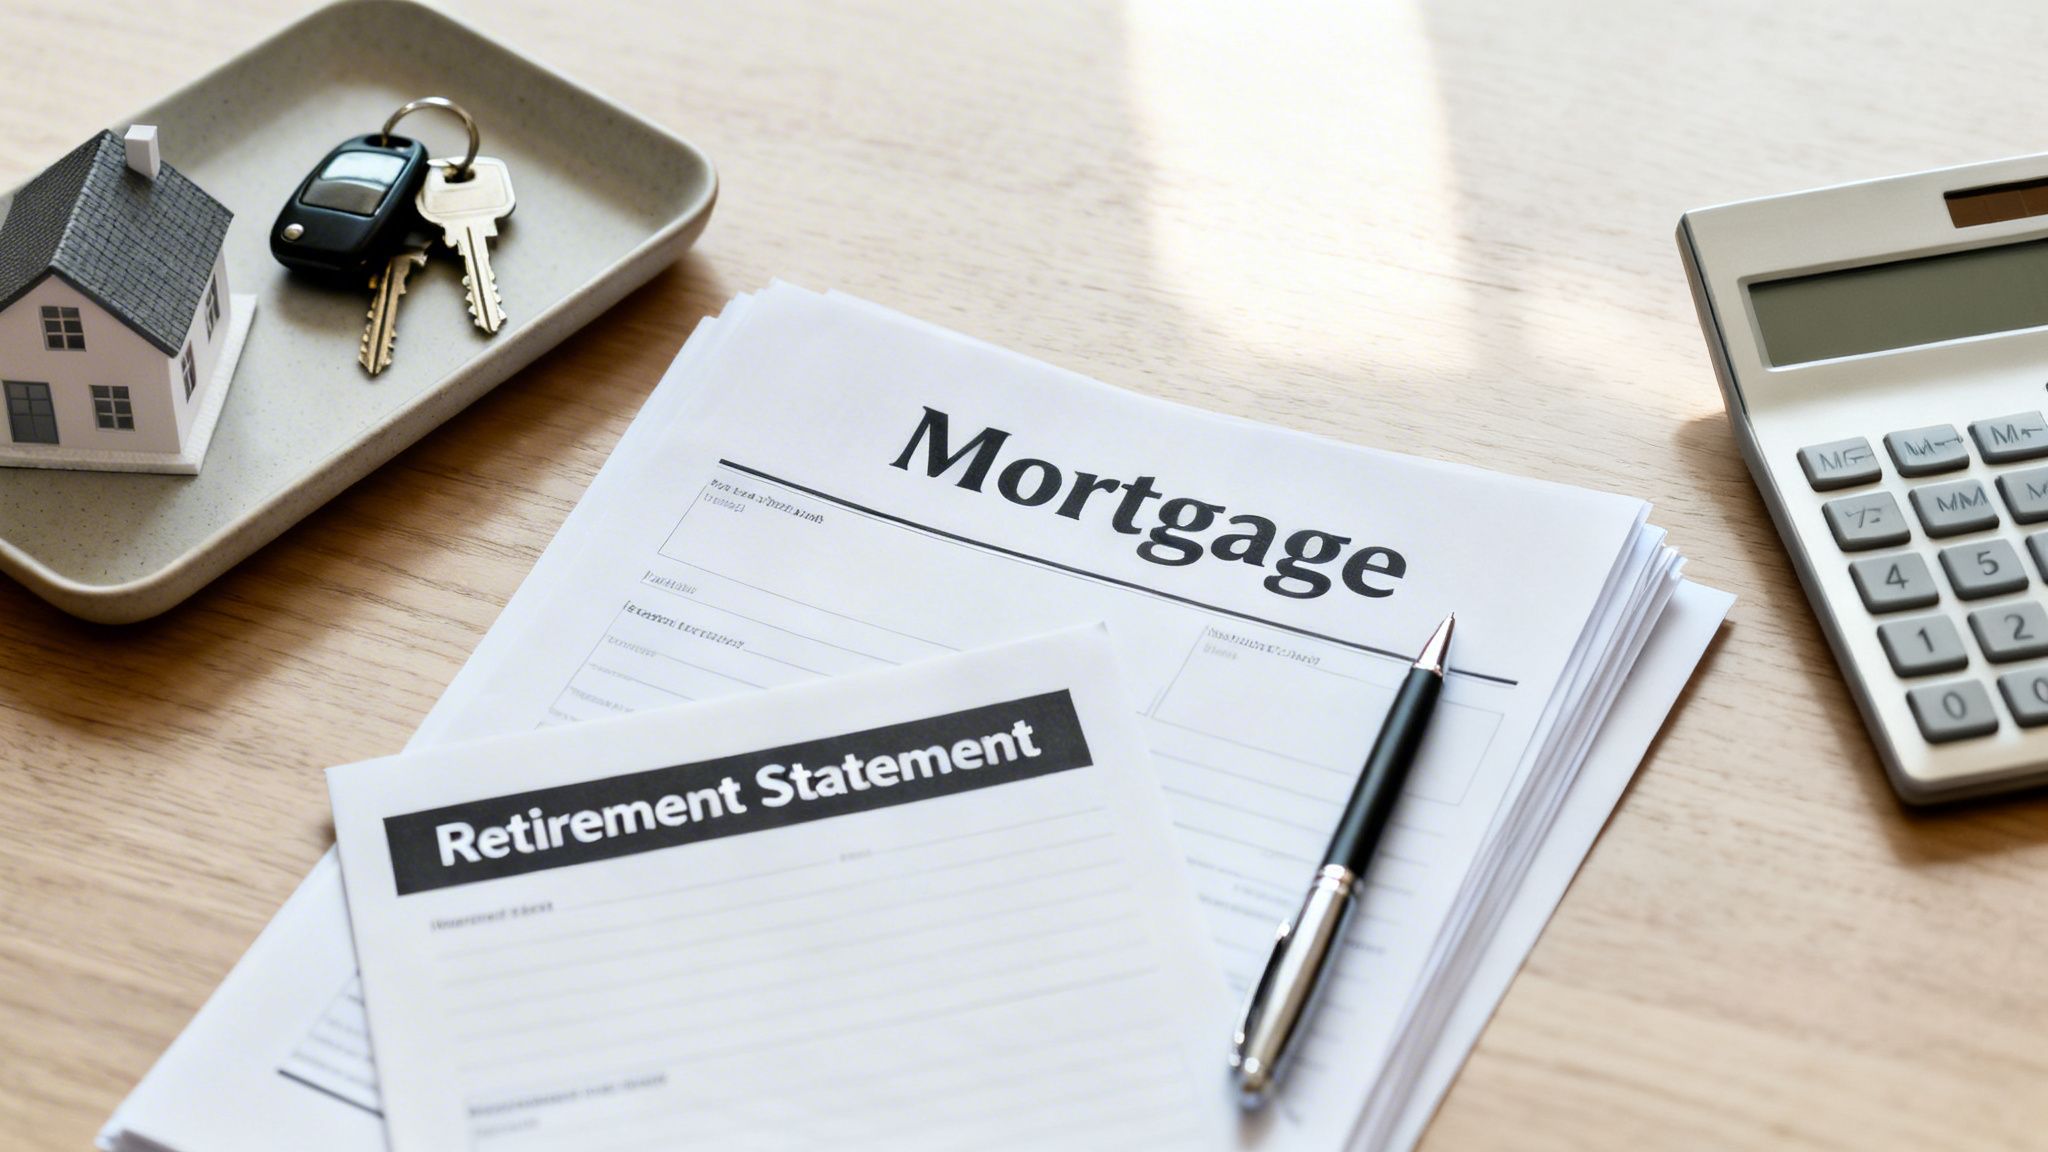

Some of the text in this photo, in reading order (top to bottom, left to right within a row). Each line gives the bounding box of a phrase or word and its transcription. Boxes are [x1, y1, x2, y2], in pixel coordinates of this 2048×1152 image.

[889, 405, 1407, 599] Mortgage
[1885, 563, 1909, 589] 4
[1976, 551, 2000, 576] 5
[1917, 627, 1935, 653] 1
[2004, 614, 2034, 641] 2
[435, 719, 1041, 867] Retirement Statement
